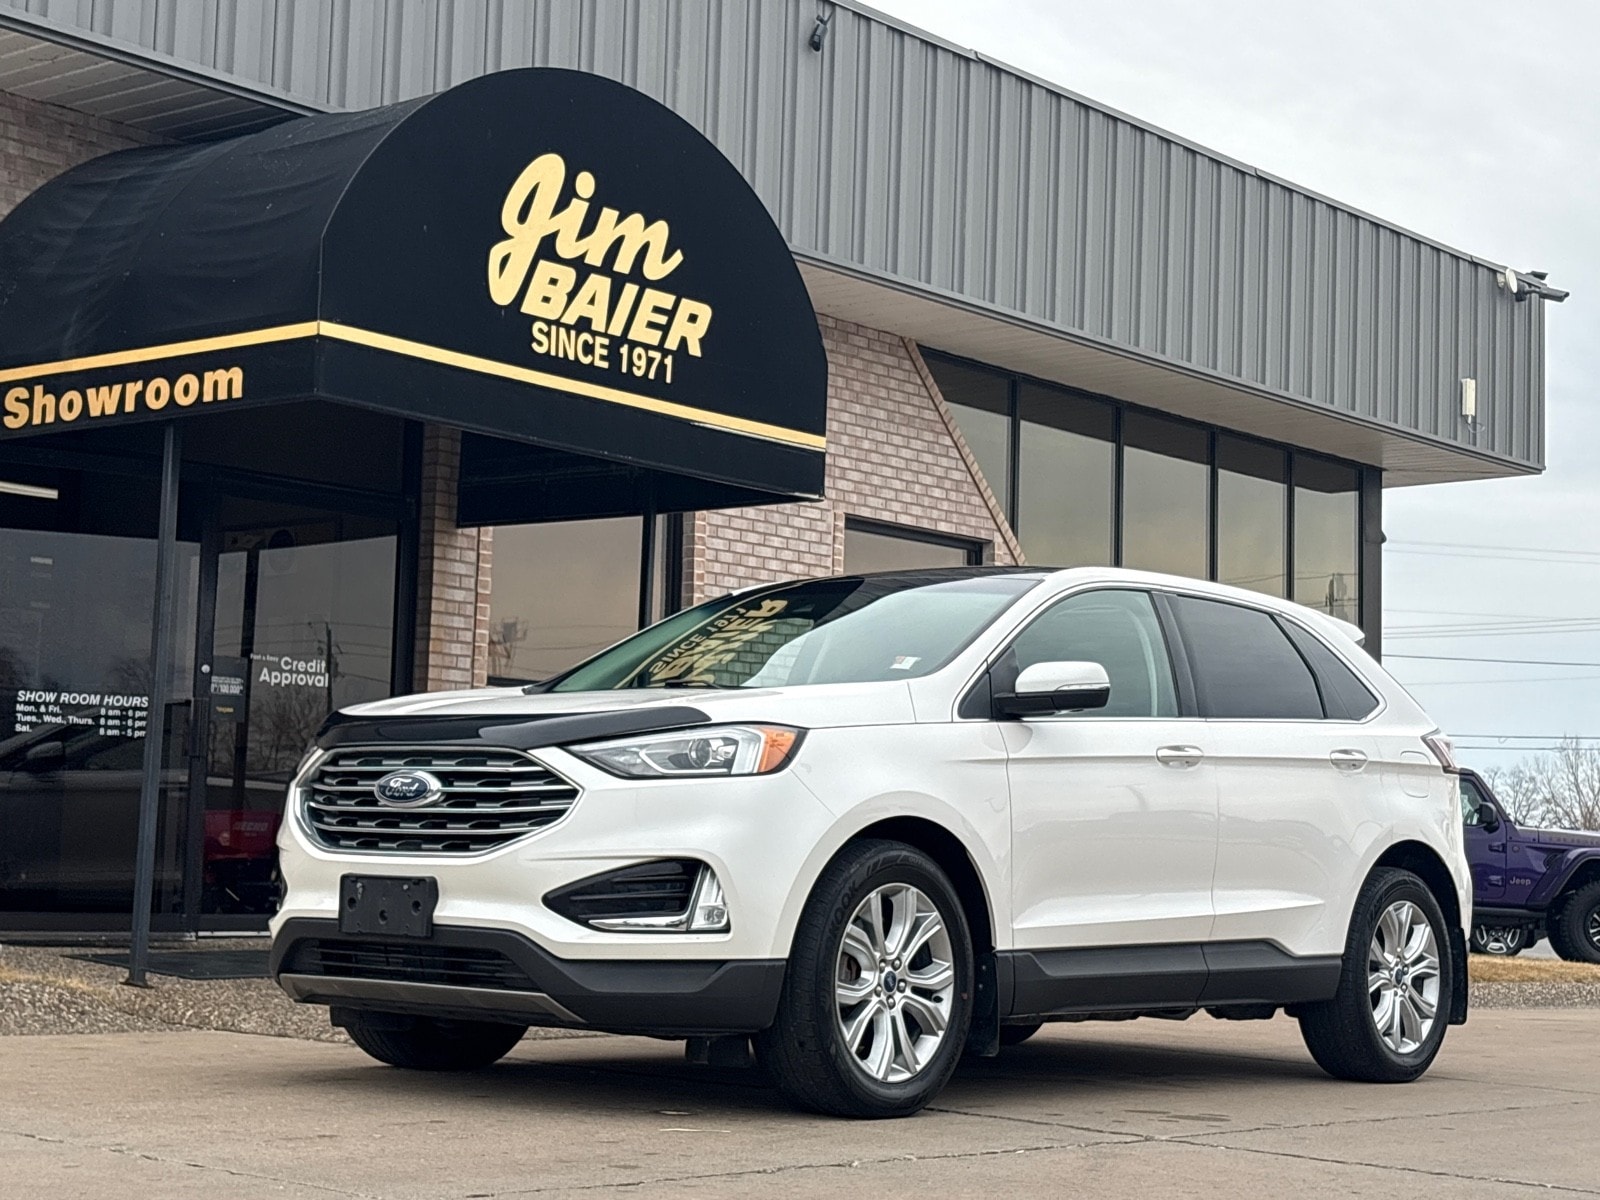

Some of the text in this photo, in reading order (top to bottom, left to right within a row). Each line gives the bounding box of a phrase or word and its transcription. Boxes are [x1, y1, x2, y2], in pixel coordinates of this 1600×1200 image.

[488, 153, 684, 306] Jim
[520, 259, 713, 358] BAIER
[531, 320, 673, 384] SINCE 1971
[3, 366, 244, 429] Showroom
[280, 656, 326, 673] Credit
[259, 667, 329, 688] Approval
[16, 690, 149, 708] SHOW ROOM HOURS
[16, 704, 38, 712] Mon.
[48, 704, 62, 714] Fri.
[15, 723, 32, 732] Sat.
[68, 715, 95, 725] Thurs.
[385, 778, 420, 797] Ford
[1510, 876, 1531, 886] Jeep
